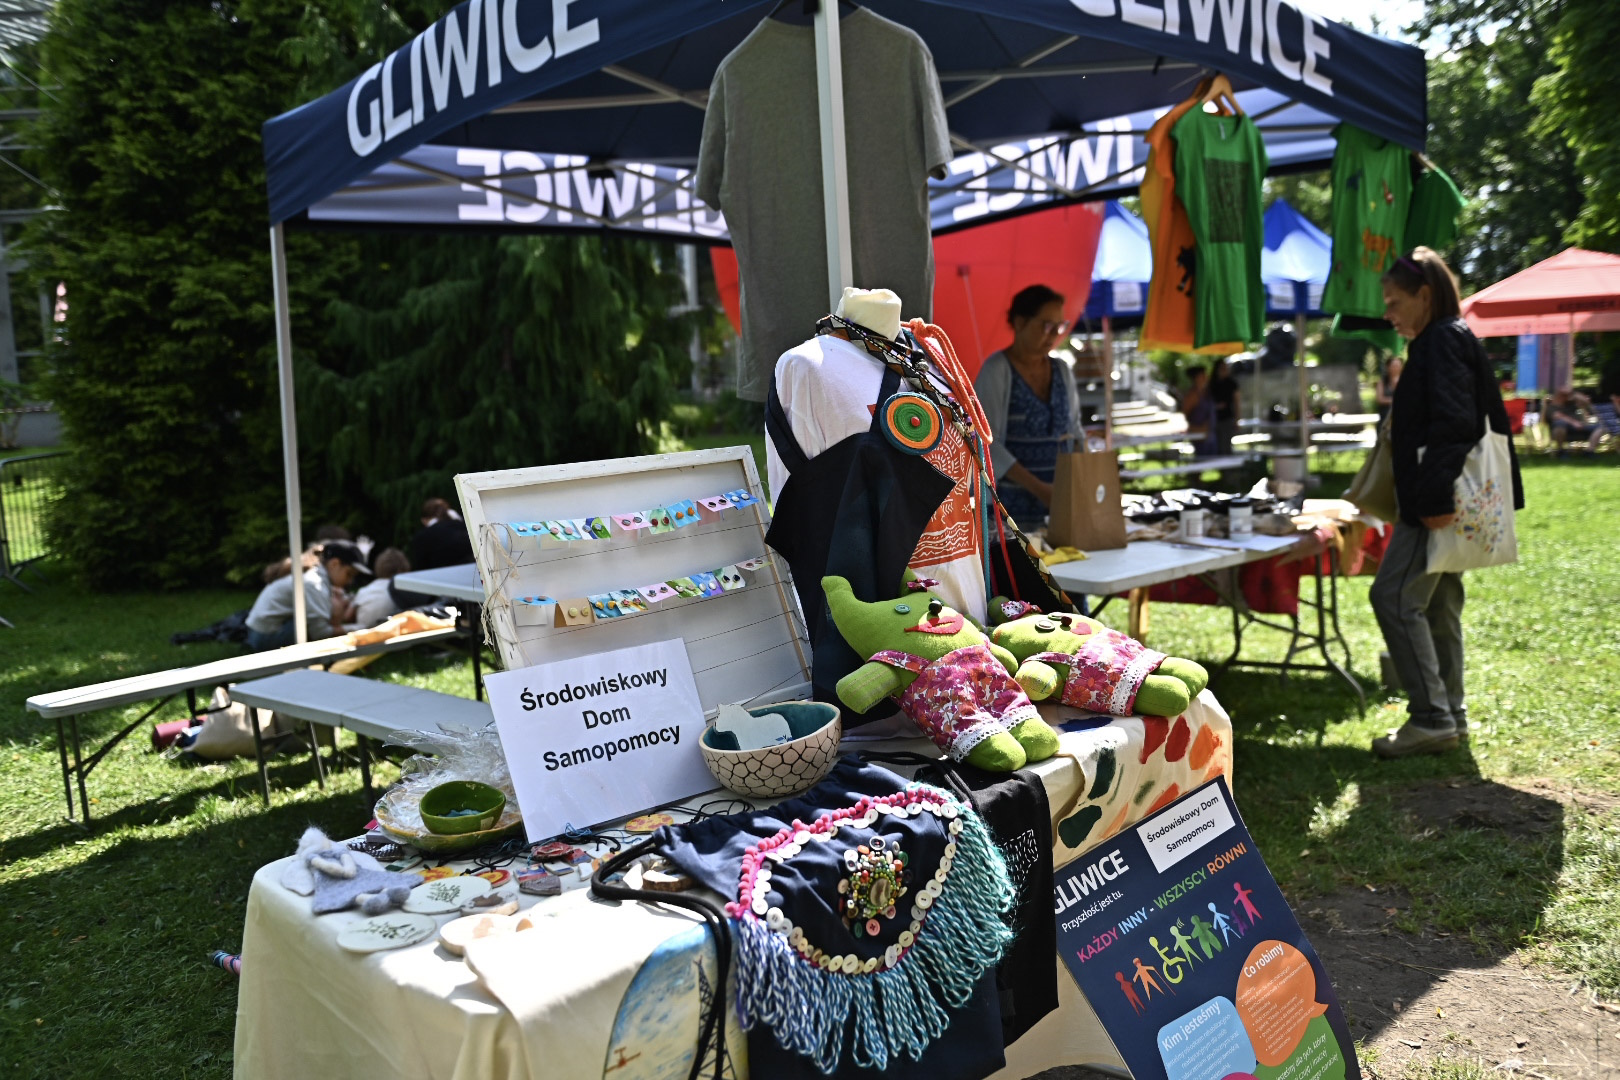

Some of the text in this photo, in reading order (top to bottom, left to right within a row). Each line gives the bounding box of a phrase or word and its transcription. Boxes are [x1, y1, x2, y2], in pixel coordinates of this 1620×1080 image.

[1069, 0, 1334, 96] WICE
[347, 0, 600, 157] GLIWICE
[520, 668, 667, 711] Środowiskowy
[582, 706, 631, 730] Dom
[543, 725, 680, 771] Samopomocy
[1147, 796, 1219, 843] Środowiskowy Dom
[1166, 818, 1215, 852] Samopomocy
[1061, 890, 1124, 933] Przyszłość jest tu.
[1076, 927, 1119, 963] KAŻDY
[1117, 907, 1148, 935] INNY
[1153, 867, 1208, 910] WSZYSCY
[1206, 842, 1248, 875] RÓWNI
[1243, 943, 1284, 978] Co robimy
[1162, 1032, 1182, 1052] Kim
[1180, 1001, 1221, 1041] jesteśmy
